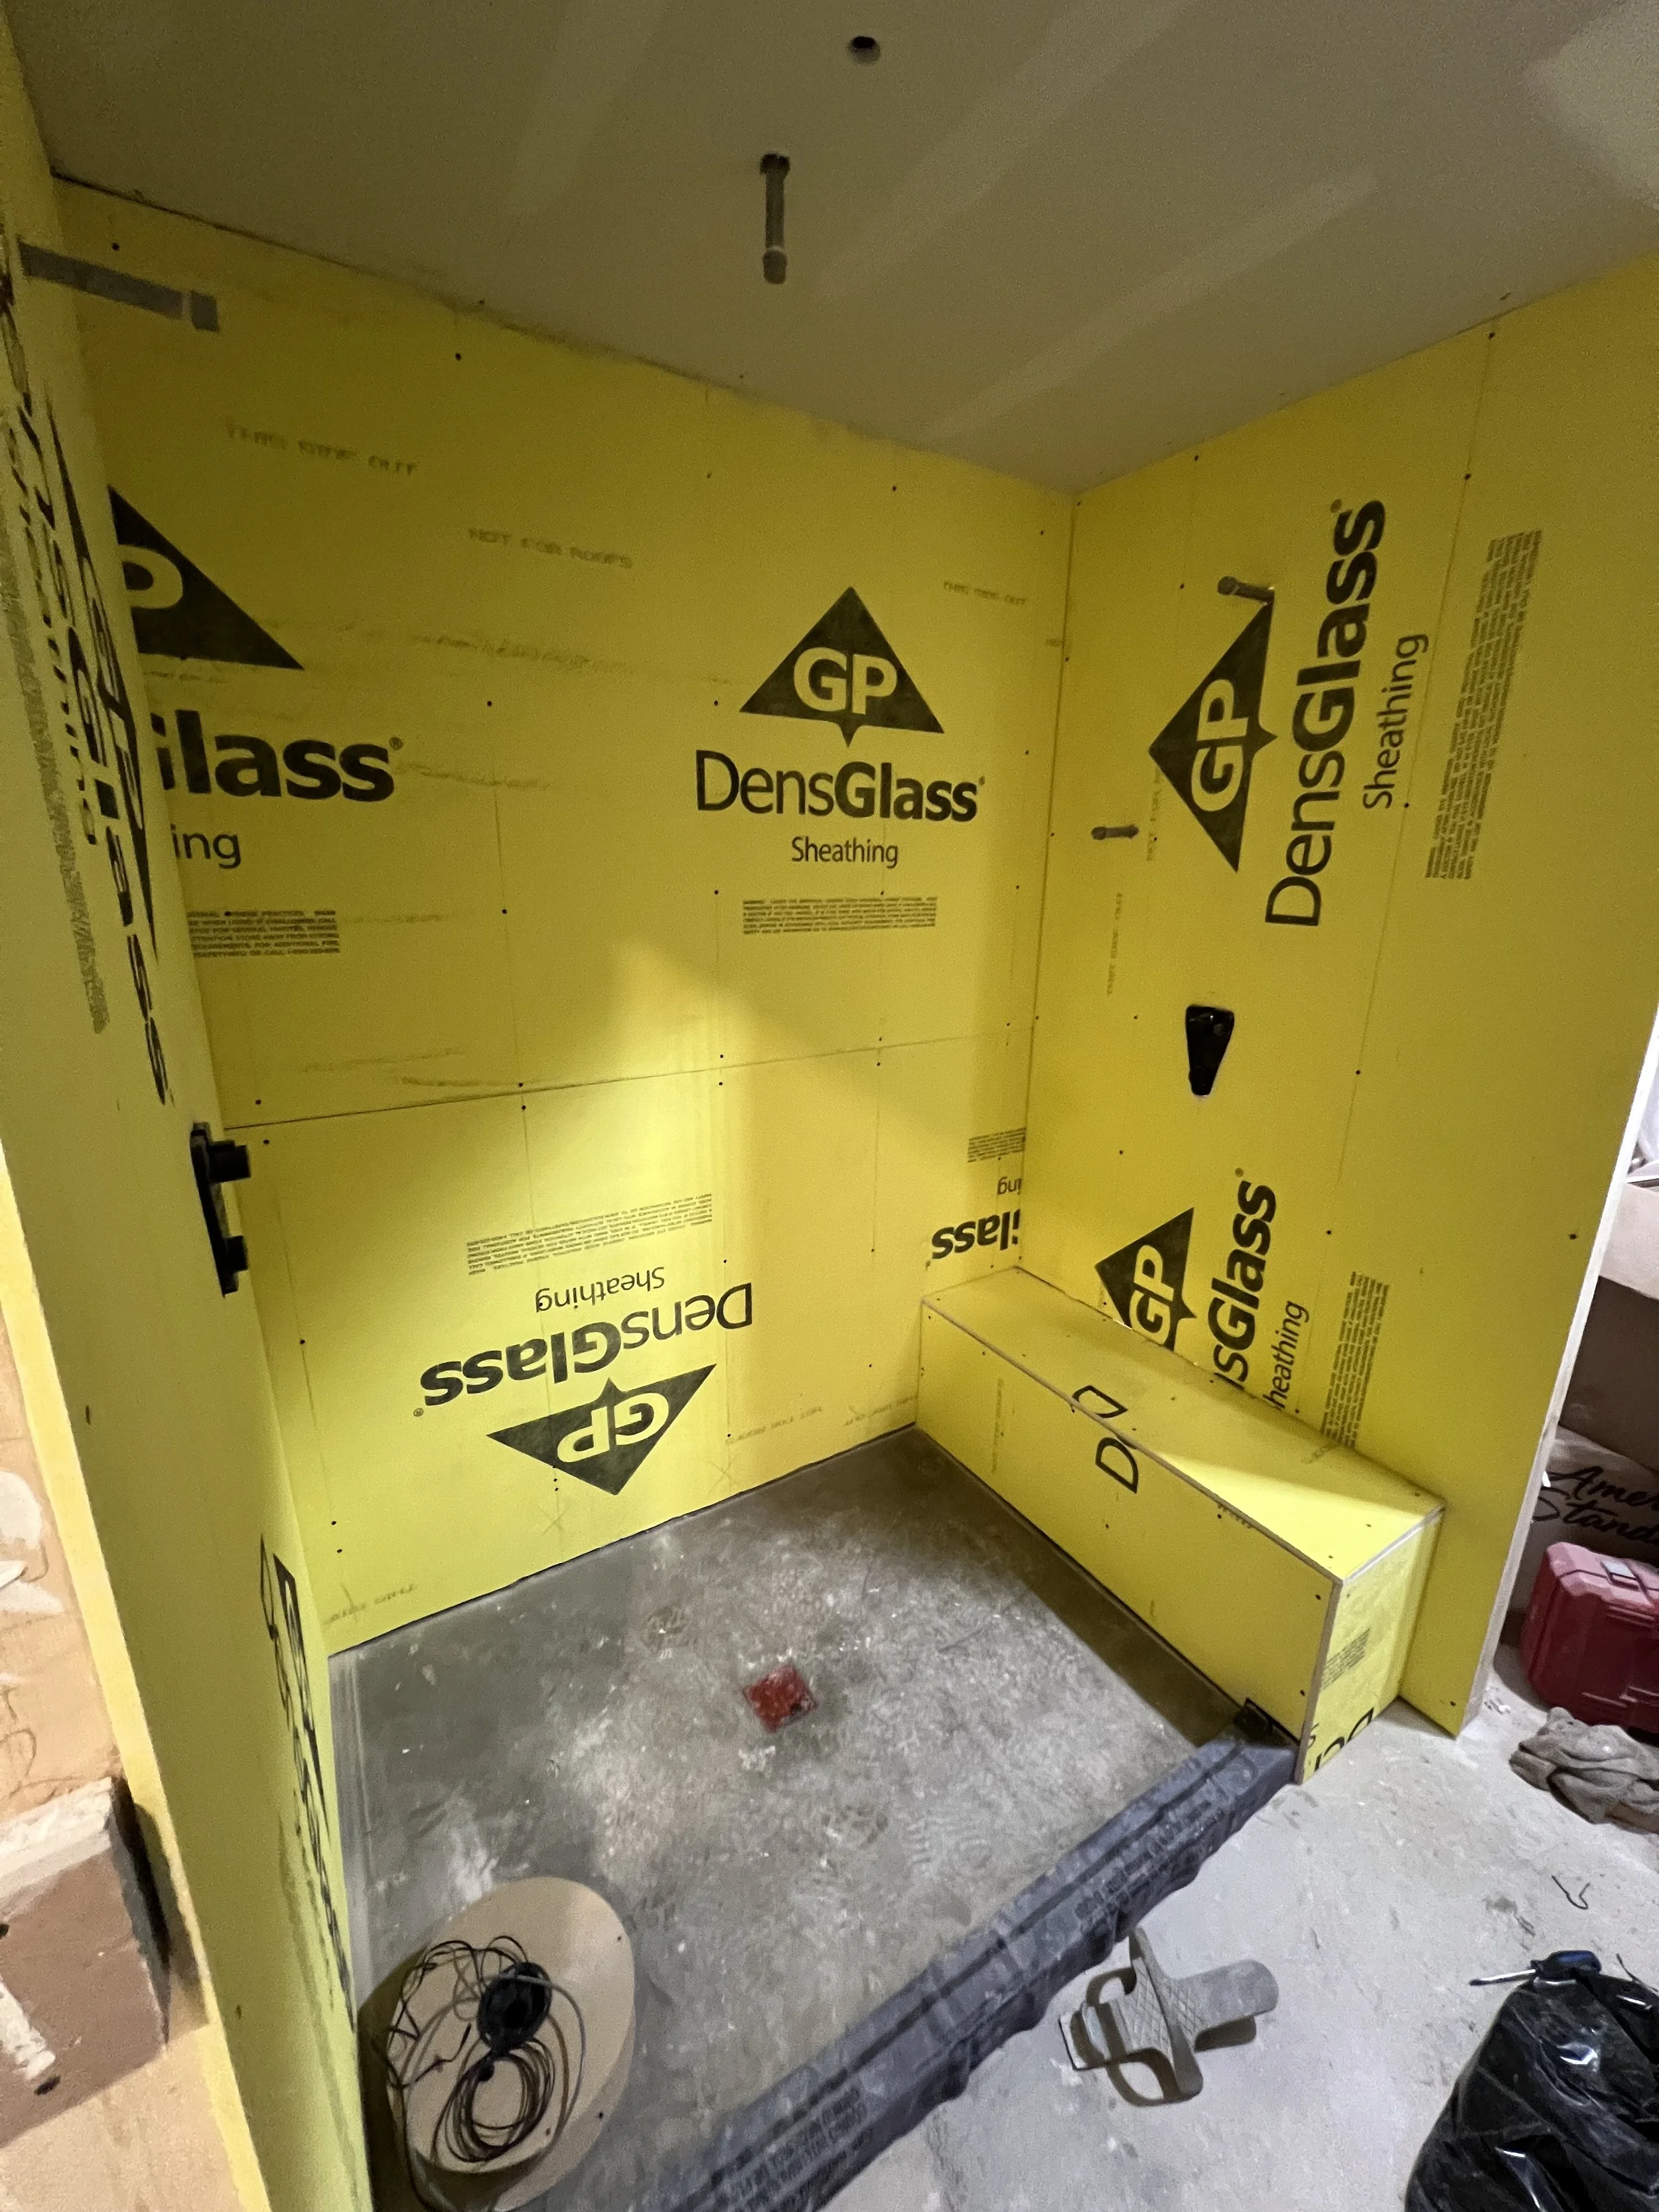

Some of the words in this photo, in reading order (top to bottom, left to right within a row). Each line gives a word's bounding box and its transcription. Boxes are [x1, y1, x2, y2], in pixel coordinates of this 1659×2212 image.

[793, 647, 898, 715] GP
[1265, 500, 1386, 926] DensGlass
[1362, 633, 1429, 810] Sheathing
[695, 749, 978, 822] DensGlass
[1191, 678, 1249, 812] GP
[791, 836, 899, 869] Sheathing
[535, 1266, 665, 1312] Sheathing
[1129, 1245, 1174, 1345] GP
[420, 1283, 753, 1406] DensGlass
[557, 1392, 669, 1463] GP
